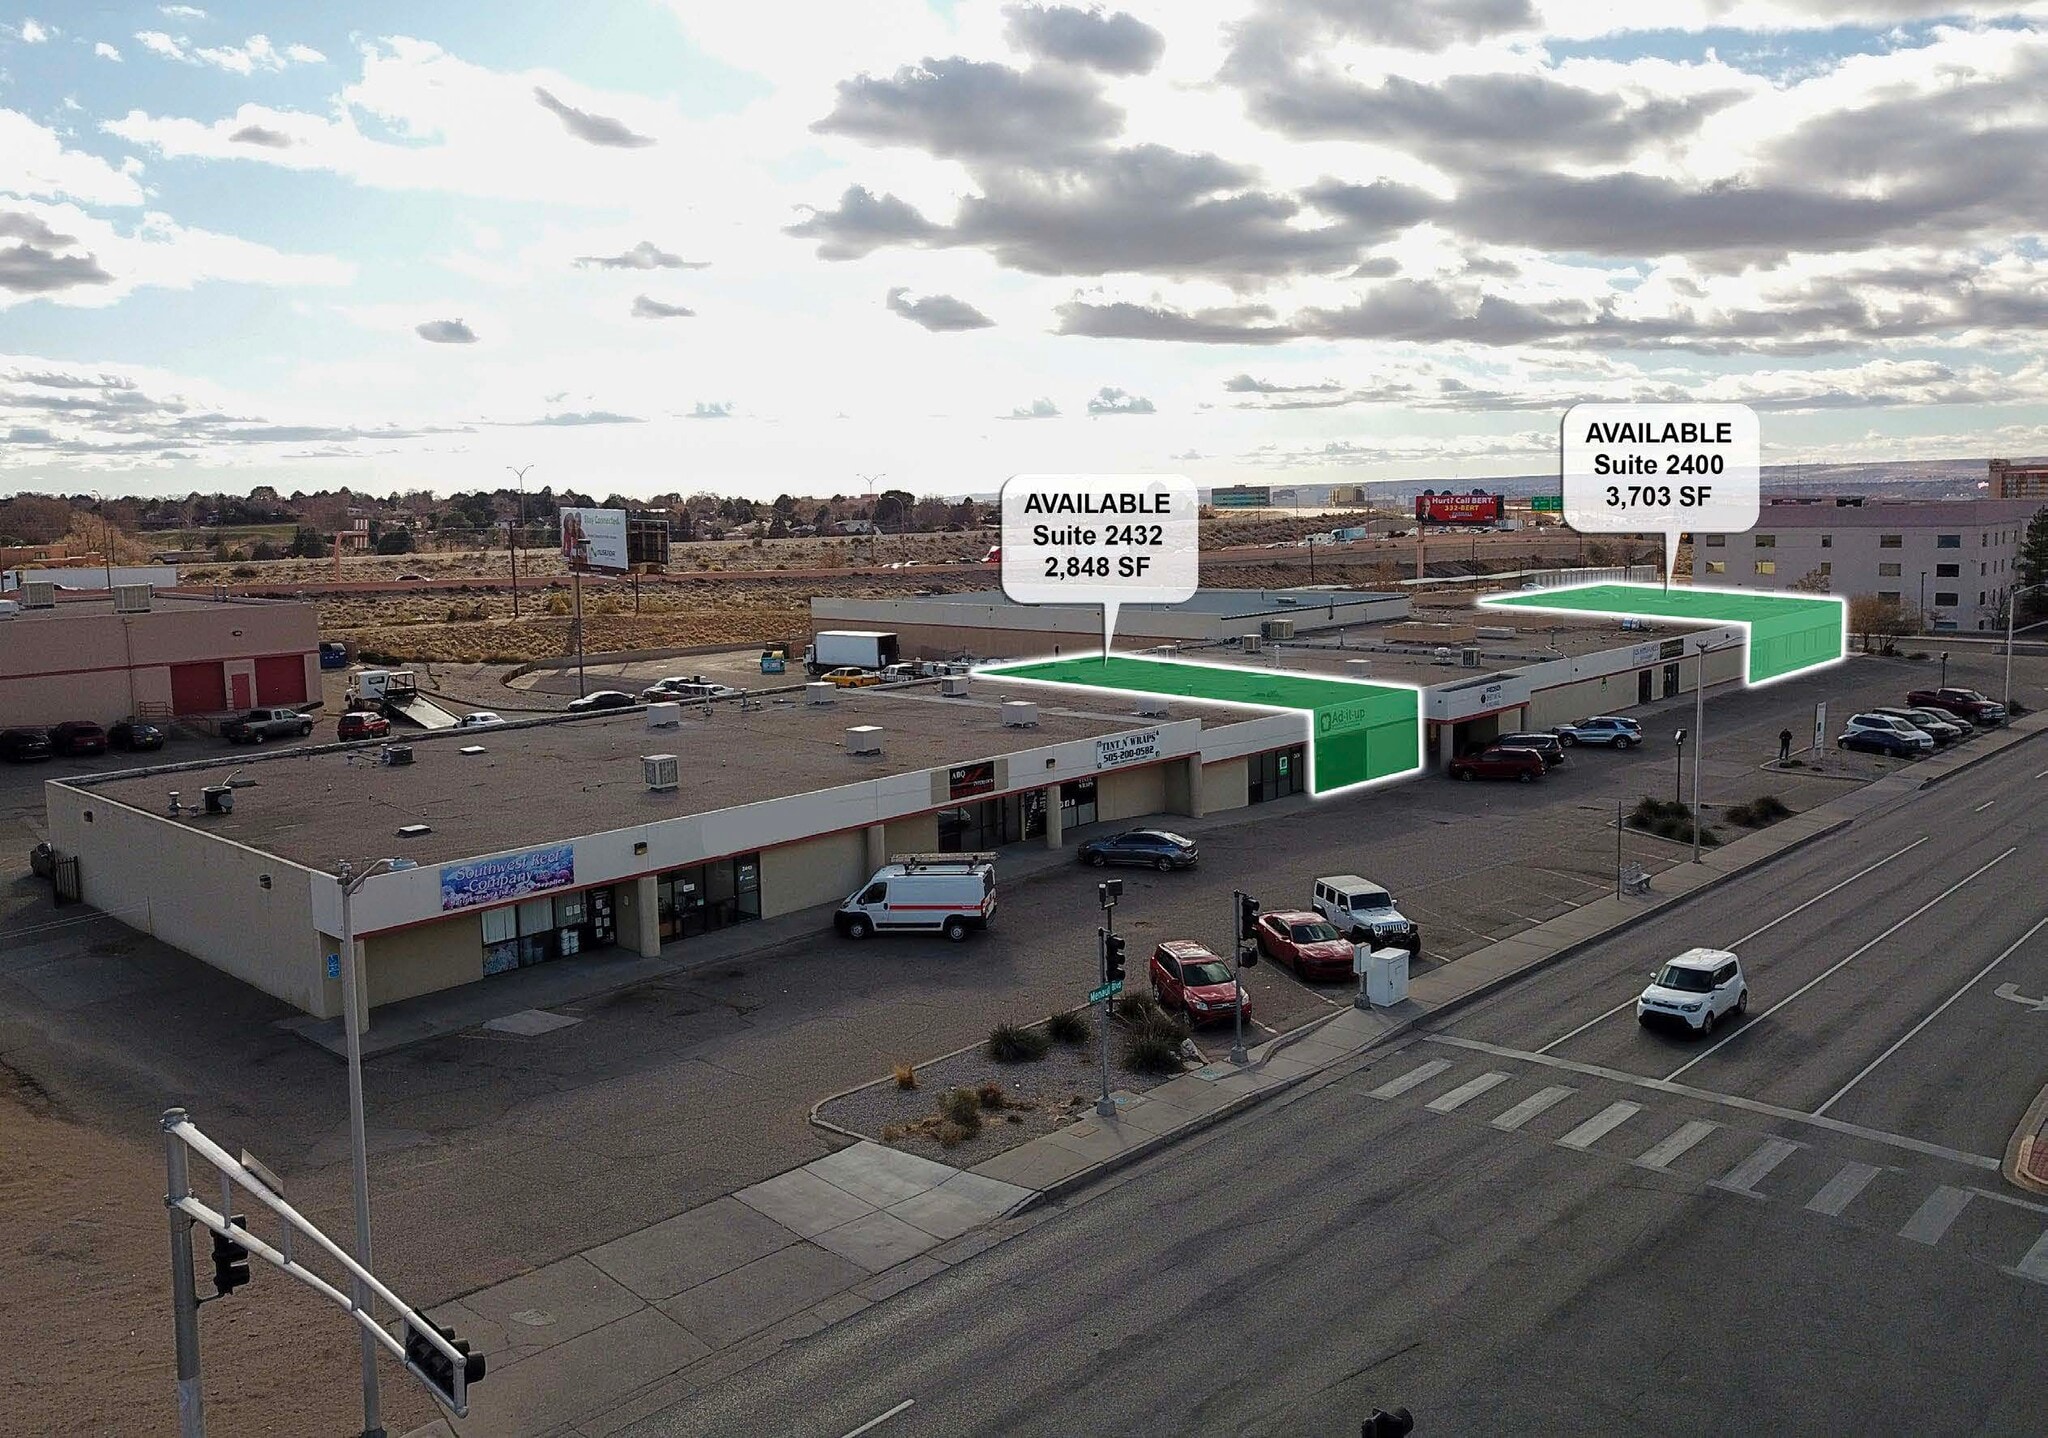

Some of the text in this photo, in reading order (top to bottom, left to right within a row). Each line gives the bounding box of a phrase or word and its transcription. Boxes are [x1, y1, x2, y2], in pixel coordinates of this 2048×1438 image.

[1432, 496, 1495, 505] Hurt? Call BERT.
[1101, 740, 1120, 751] TINT
[1129, 733, 1156, 746] WRAPS
[1103, 745, 1155, 763] 505-200-0582
[455, 857, 528, 881] Southwest
[532, 850, 561, 867] Reef
[469, 870, 533, 893] Company
